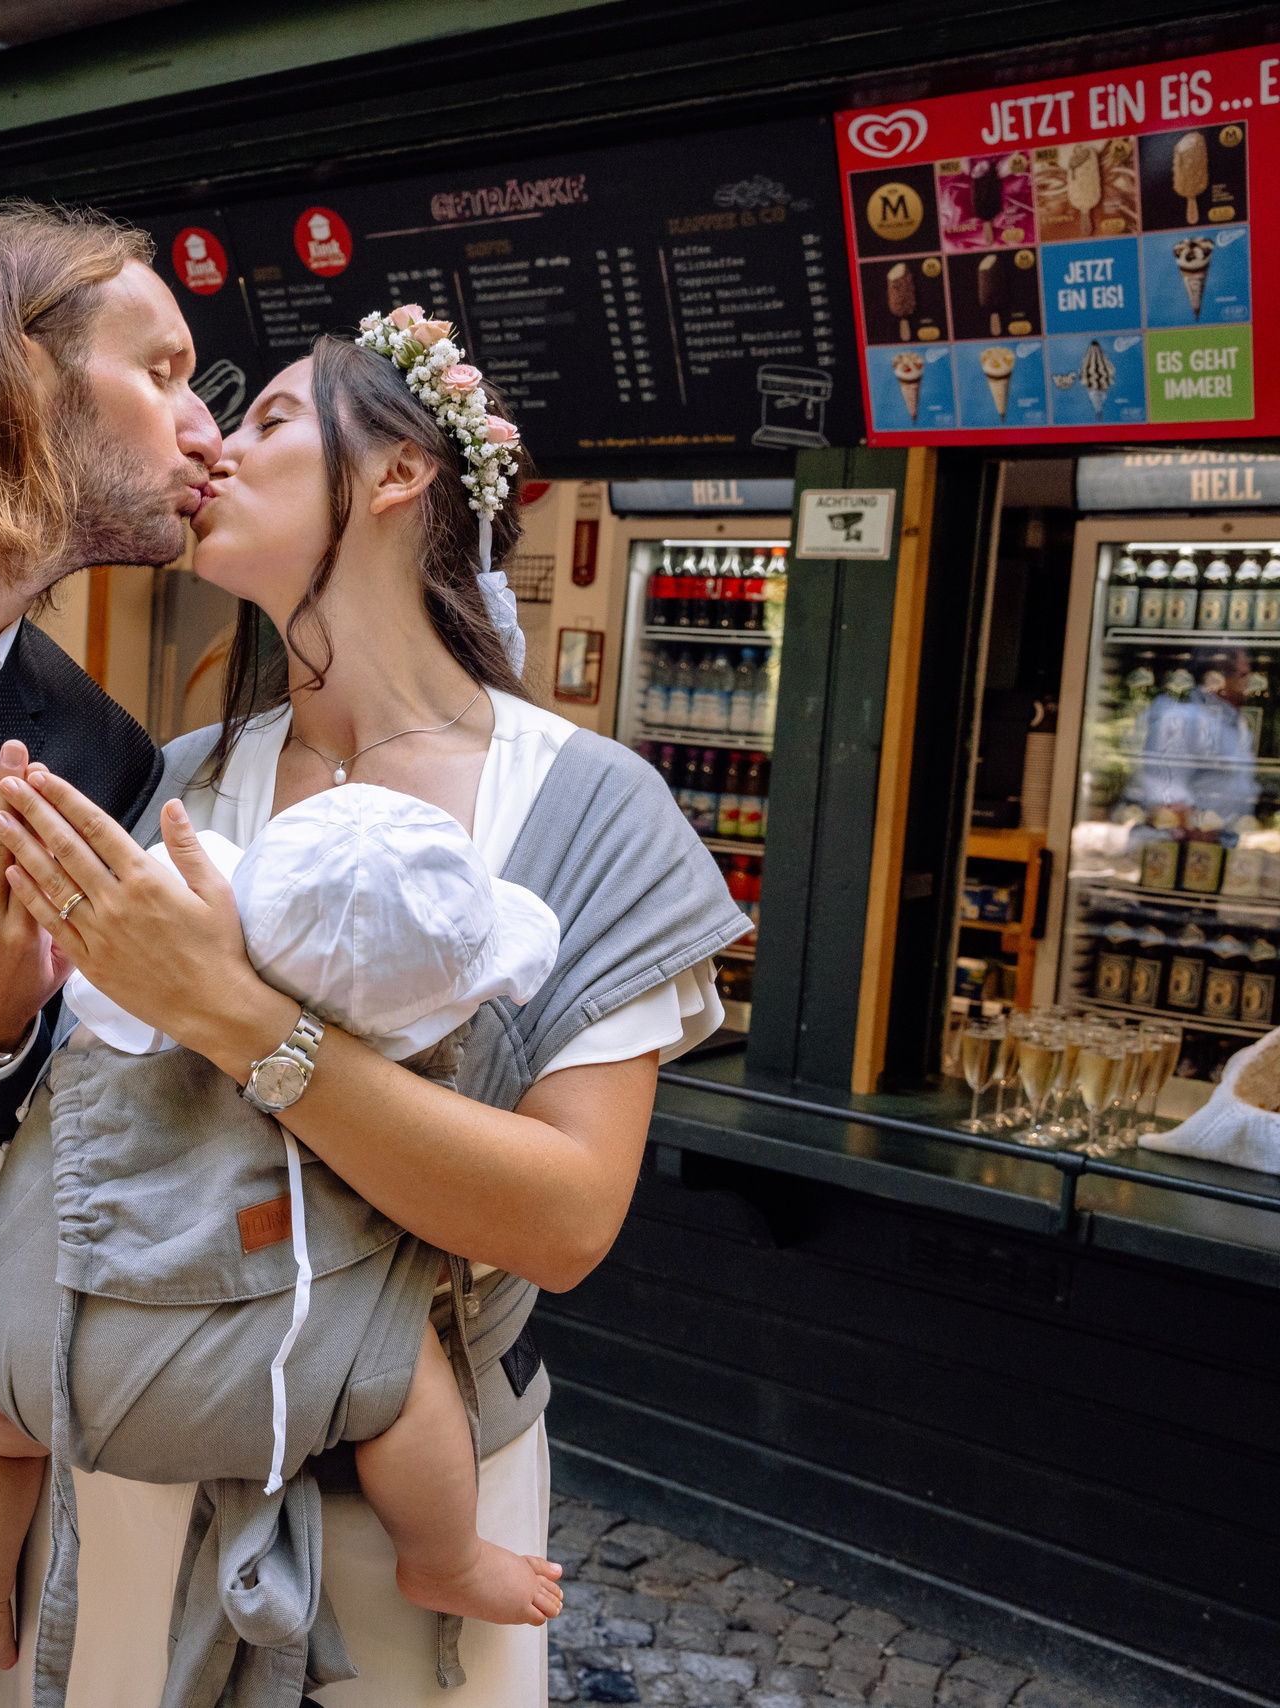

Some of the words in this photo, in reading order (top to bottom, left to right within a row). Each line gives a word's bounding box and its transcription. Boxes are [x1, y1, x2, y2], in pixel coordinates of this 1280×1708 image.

[981, 90, 1075, 145] JETZT
[431, 175, 589, 222] GETRÄNKE
[1064, 258, 1115, 285] JETZT
[1189, 346, 1239, 372] GEHT
[692, 480, 744, 506] HELL
[1189, 466, 1262, 502] HELL
[816, 496, 878, 508] ACHTUNG
